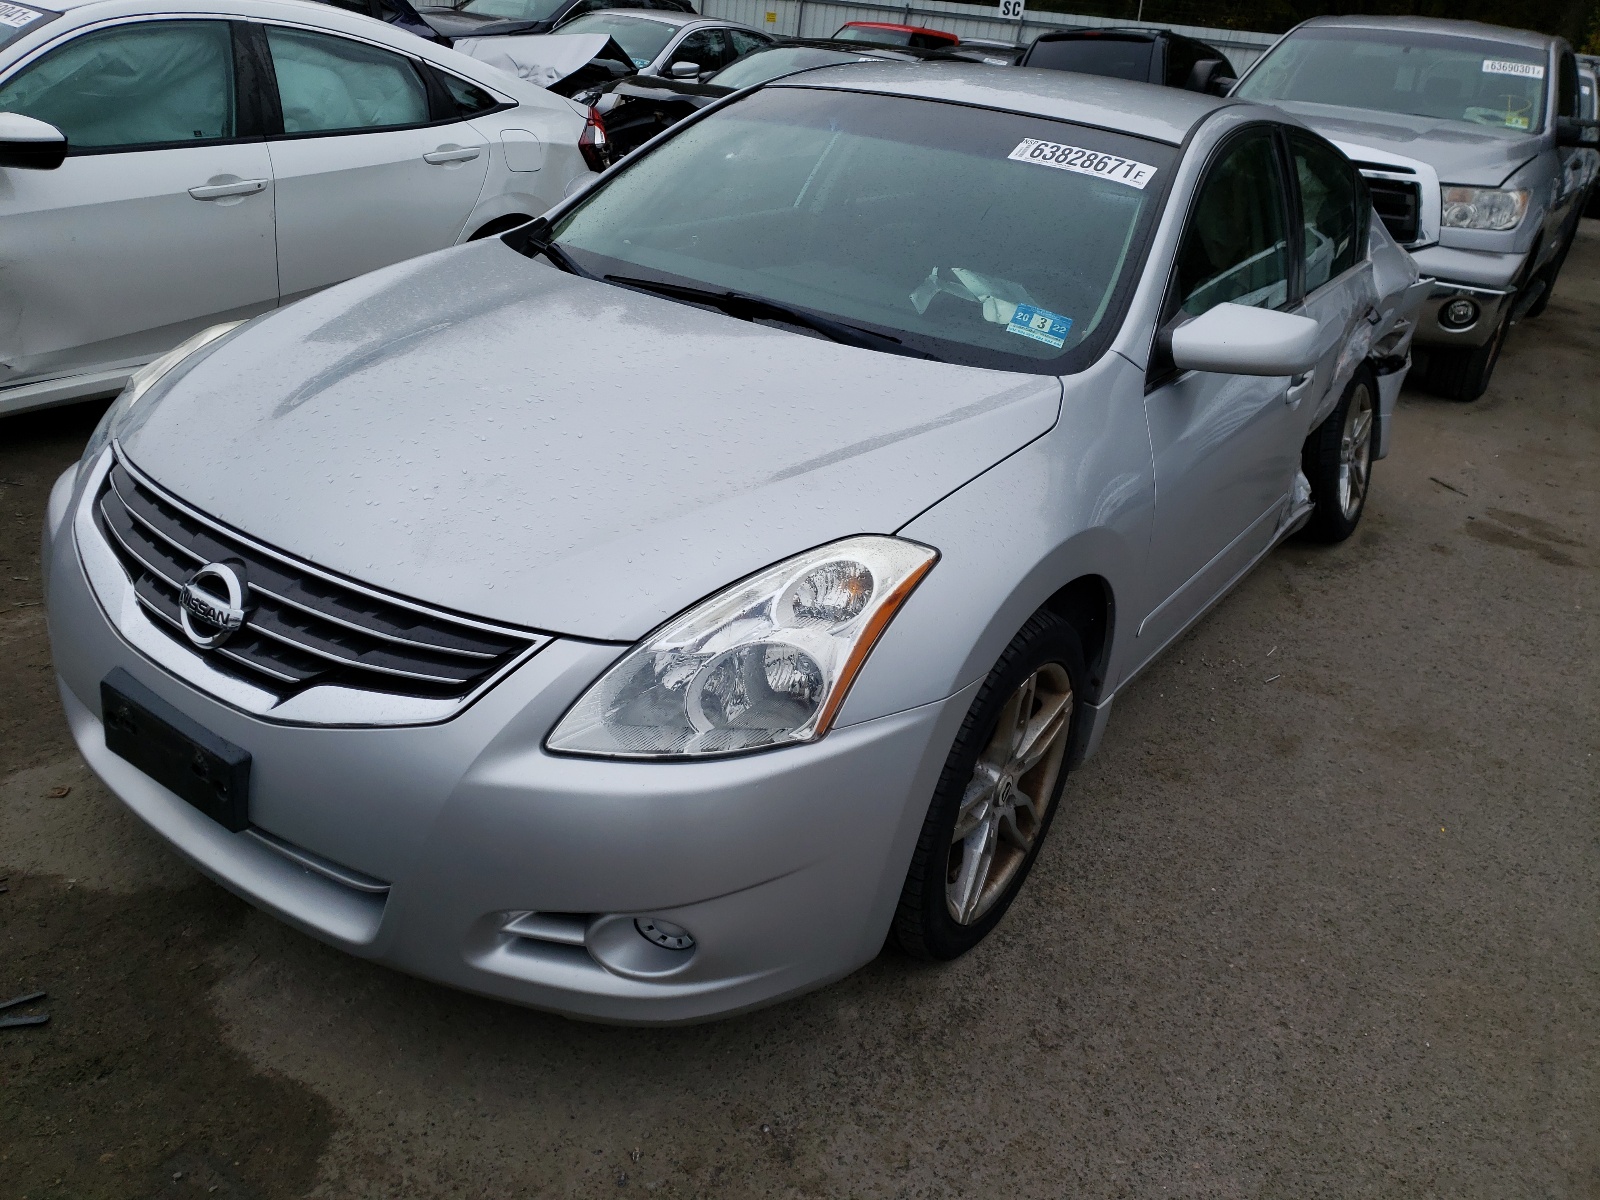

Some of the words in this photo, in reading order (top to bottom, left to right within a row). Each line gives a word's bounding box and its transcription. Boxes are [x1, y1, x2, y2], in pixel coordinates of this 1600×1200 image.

[1002, 0, 1021, 17] SC
[1490, 61, 1536, 75] 63690301
[1029, 142, 1137, 179] 63828671
[1134, 170, 1146, 180] F
[1015, 312, 1030, 322] 20
[1036, 317, 1048, 329] 3
[1052, 324, 1067, 334] 22
[180, 587, 230, 625] NISSAN
